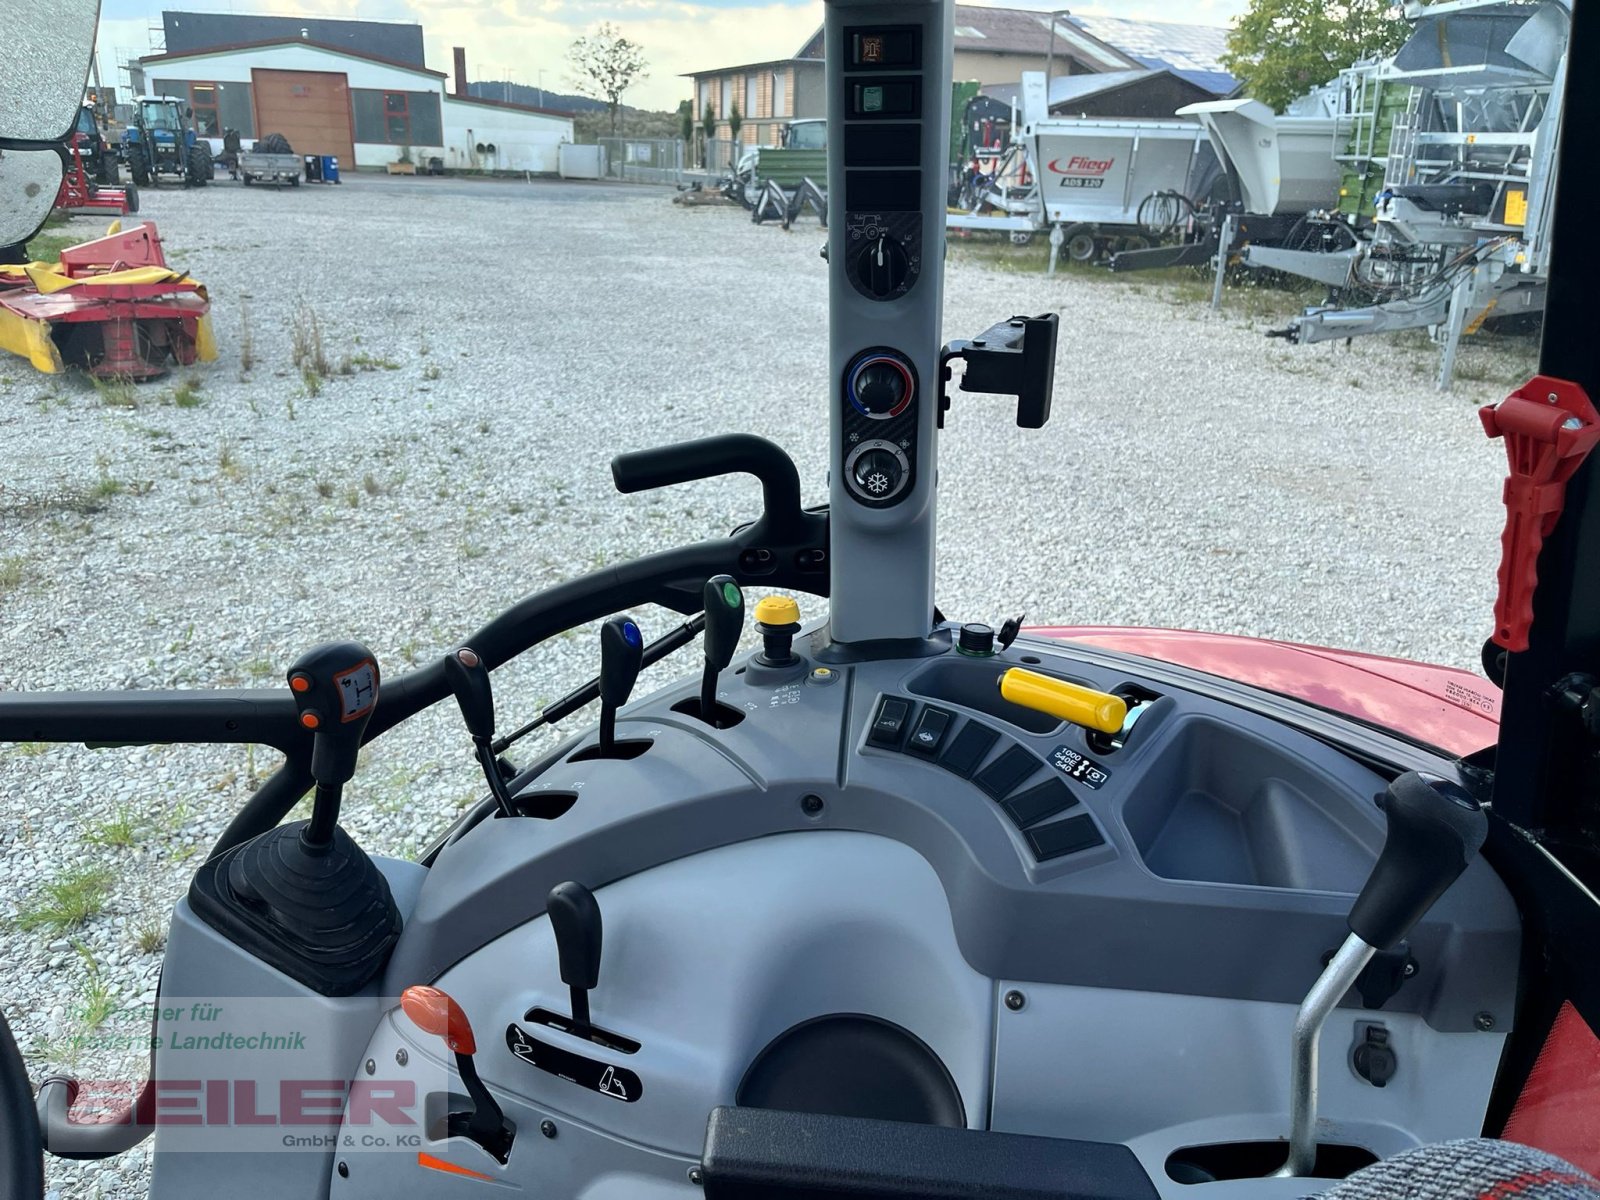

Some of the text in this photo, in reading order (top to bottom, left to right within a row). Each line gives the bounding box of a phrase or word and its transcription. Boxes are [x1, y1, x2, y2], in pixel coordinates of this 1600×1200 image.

[1068, 156, 1115, 173] Fliegl
[1085, 179, 1101, 187] 120
[1054, 752, 1077, 767] 540E
[1062, 748, 1081, 761] 1000
[1056, 760, 1071, 771] 540
